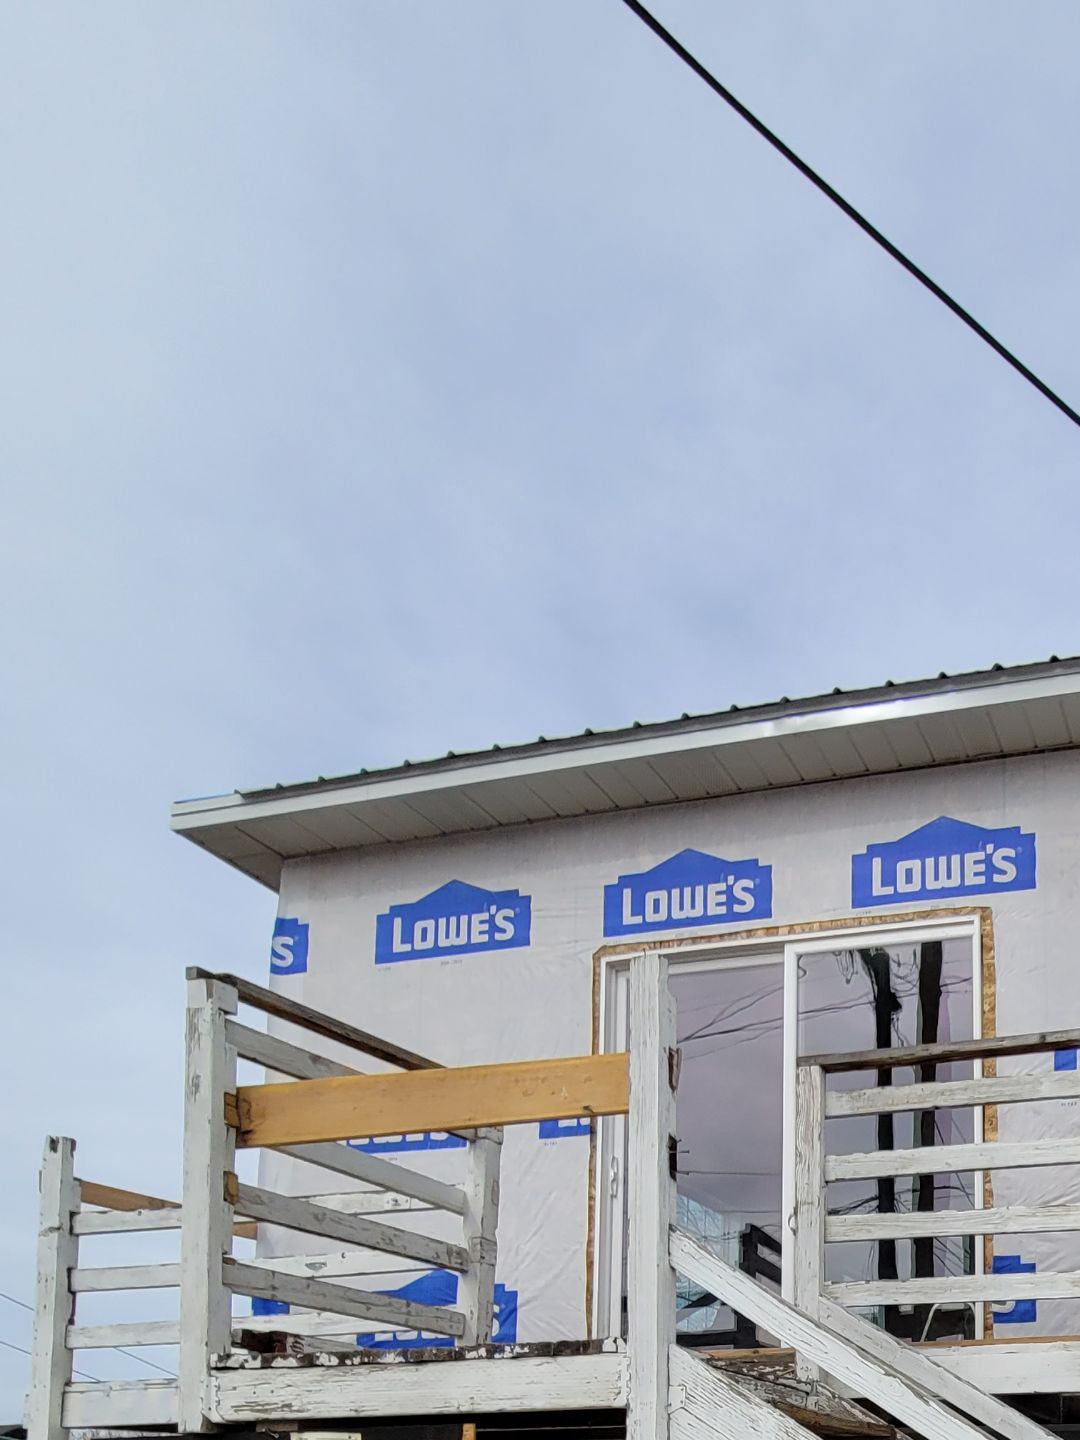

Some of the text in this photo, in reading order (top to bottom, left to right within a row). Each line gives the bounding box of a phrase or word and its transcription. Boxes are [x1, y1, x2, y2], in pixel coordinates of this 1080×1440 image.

[872, 843, 1018, 897] LOWE'S
[622, 876, 756, 926] LOWE'S
[393, 905, 516, 953] LOWE'S
